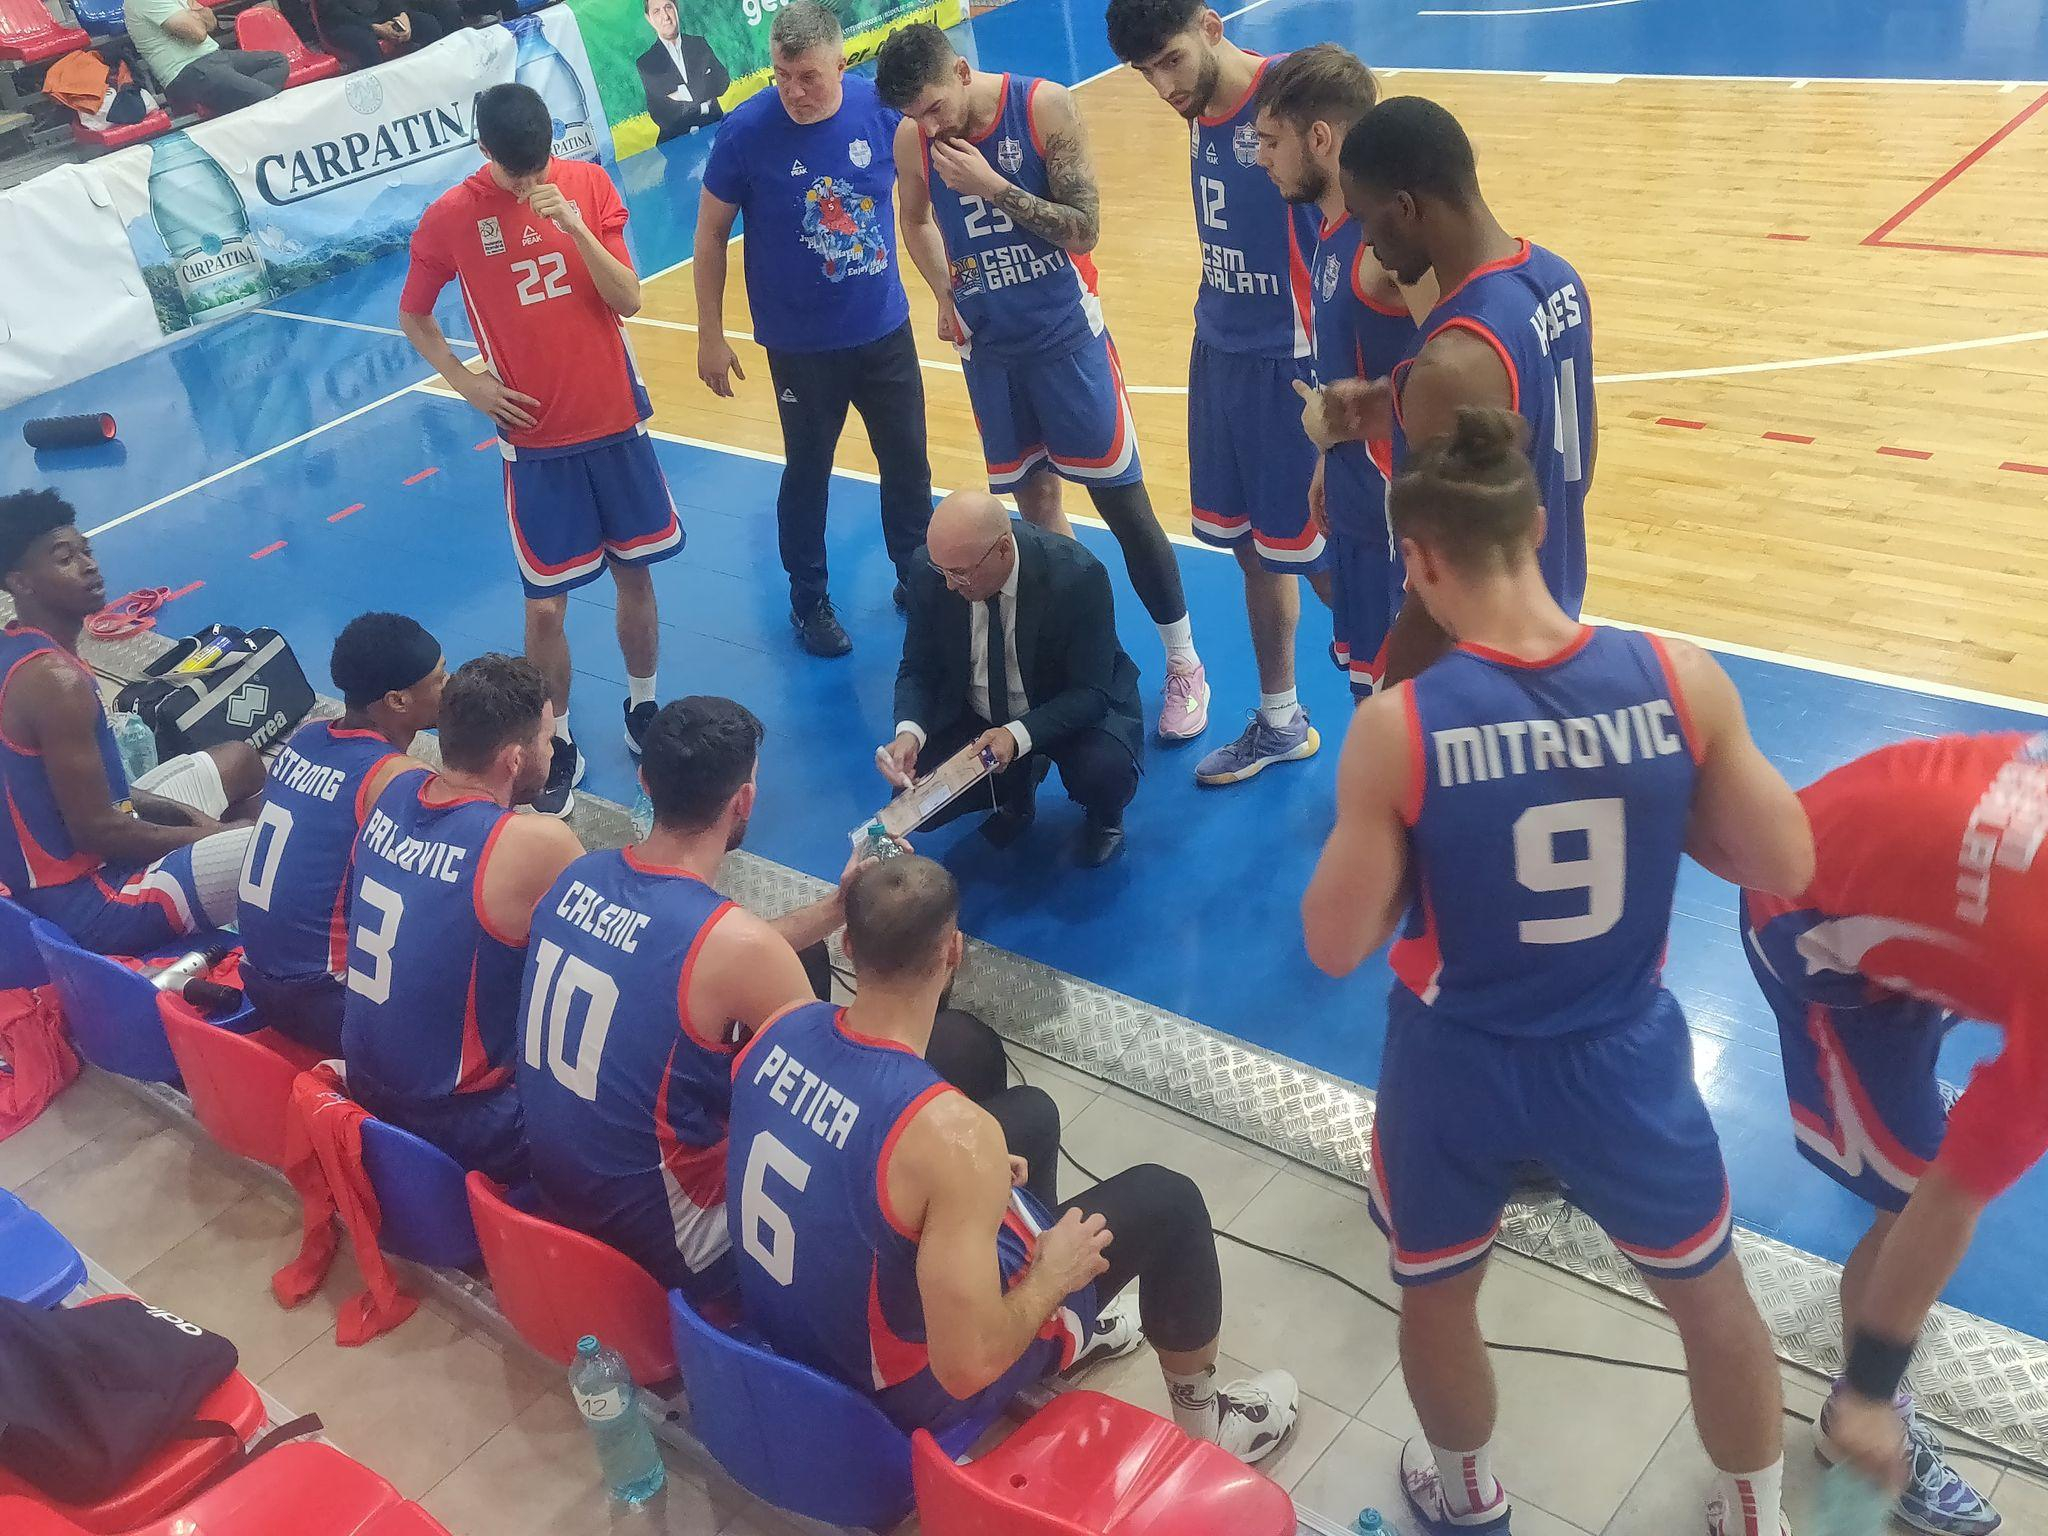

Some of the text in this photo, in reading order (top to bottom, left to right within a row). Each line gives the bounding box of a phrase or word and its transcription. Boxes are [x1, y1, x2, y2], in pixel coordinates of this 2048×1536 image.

[553, 132, 592, 156] PATINA
[790, 167, 808, 177] PEAK
[1200, 175, 1228, 231] 12
[182, 246, 256, 283] CARPATINA
[521, 234, 543, 247] PEAK
[979, 243, 1036, 270] CSM
[1202, 242, 1245, 272] CSM
[510, 251, 572, 306] 22
[984, 250, 1065, 291] GALATI
[1204, 264, 1279, 296] GALATI
[1430, 699, 1682, 787] MITROVIC
[272, 746, 346, 802] STRONG
[238, 799, 294, 913] 0
[1512, 797, 1627, 945] 9
[347, 875, 404, 1005] 3
[556, 880, 652, 954] CALENIC
[522, 937, 620, 1101] 10
[753, 1044, 860, 1151] PETICA
[741, 1129, 811, 1286] 6
[582, 1399, 617, 1418] 12
